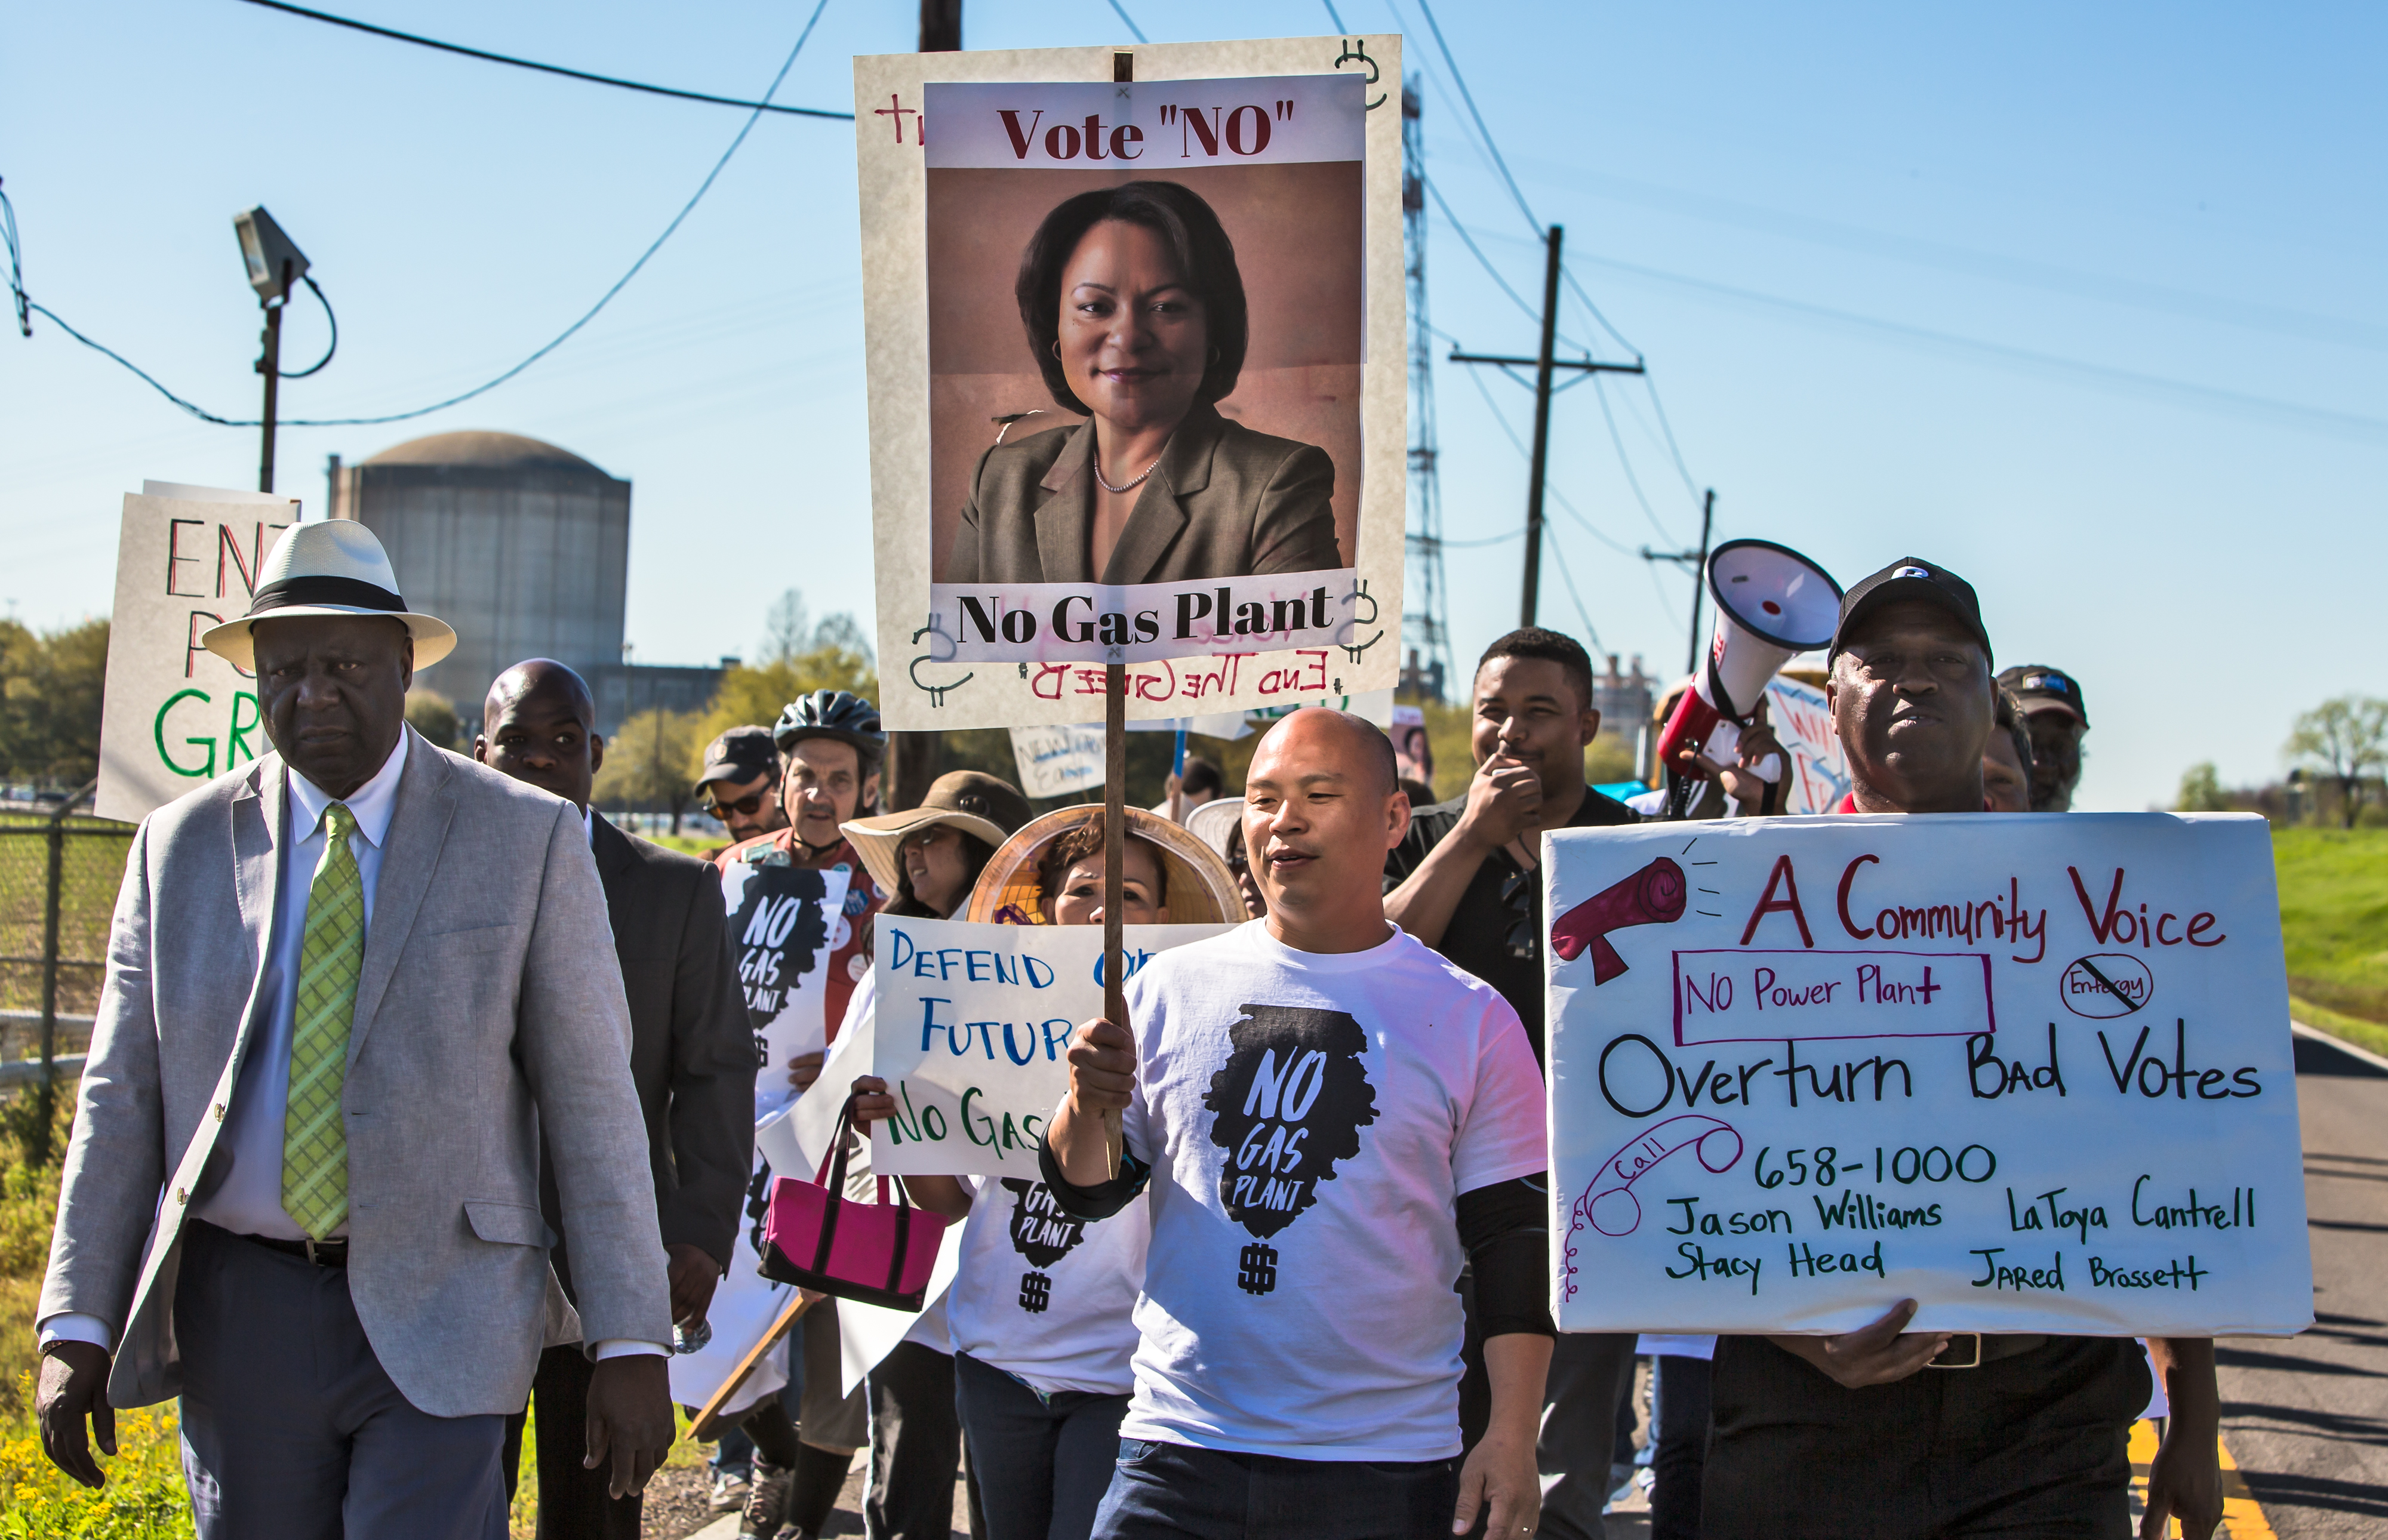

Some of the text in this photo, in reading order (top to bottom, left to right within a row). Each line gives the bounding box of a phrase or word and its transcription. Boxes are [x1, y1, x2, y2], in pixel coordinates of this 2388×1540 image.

[996, 100, 1294, 160] Vote "NO"
[167, 518, 290, 599] EN
[956, 586, 1334, 646] No Gas Plant
[155, 688, 260, 778] GR
[743, 894, 801, 948] NO
[1740, 854, 2226, 963] A Community Voice
[738, 948, 784, 986] GAS
[890, 928, 1054, 989] DEFEND
[1686, 964, 1941, 1015] NO Power Plant
[919, 997, 1073, 1066] FUTUR
[1243, 1046, 1327, 1122] NO
[1598, 1033, 1912, 1119] Overturn
[2097, 1018, 2261, 1099] Votes
[1236, 1122, 1309, 1174] GAS
[1614, 1136, 1666, 1179] Call
[1755, 1144, 1997, 1189] 658-1000
[1233, 1175, 1304, 1212] PLANT
[1666, 1189, 1942, 1235] Jason Williams
[2007, 1174, 2255, 1245] LaToya Cantrell
[1018, 1215, 1075, 1248] PLANT
[1666, 1241, 1885, 1295] Stacy Head
